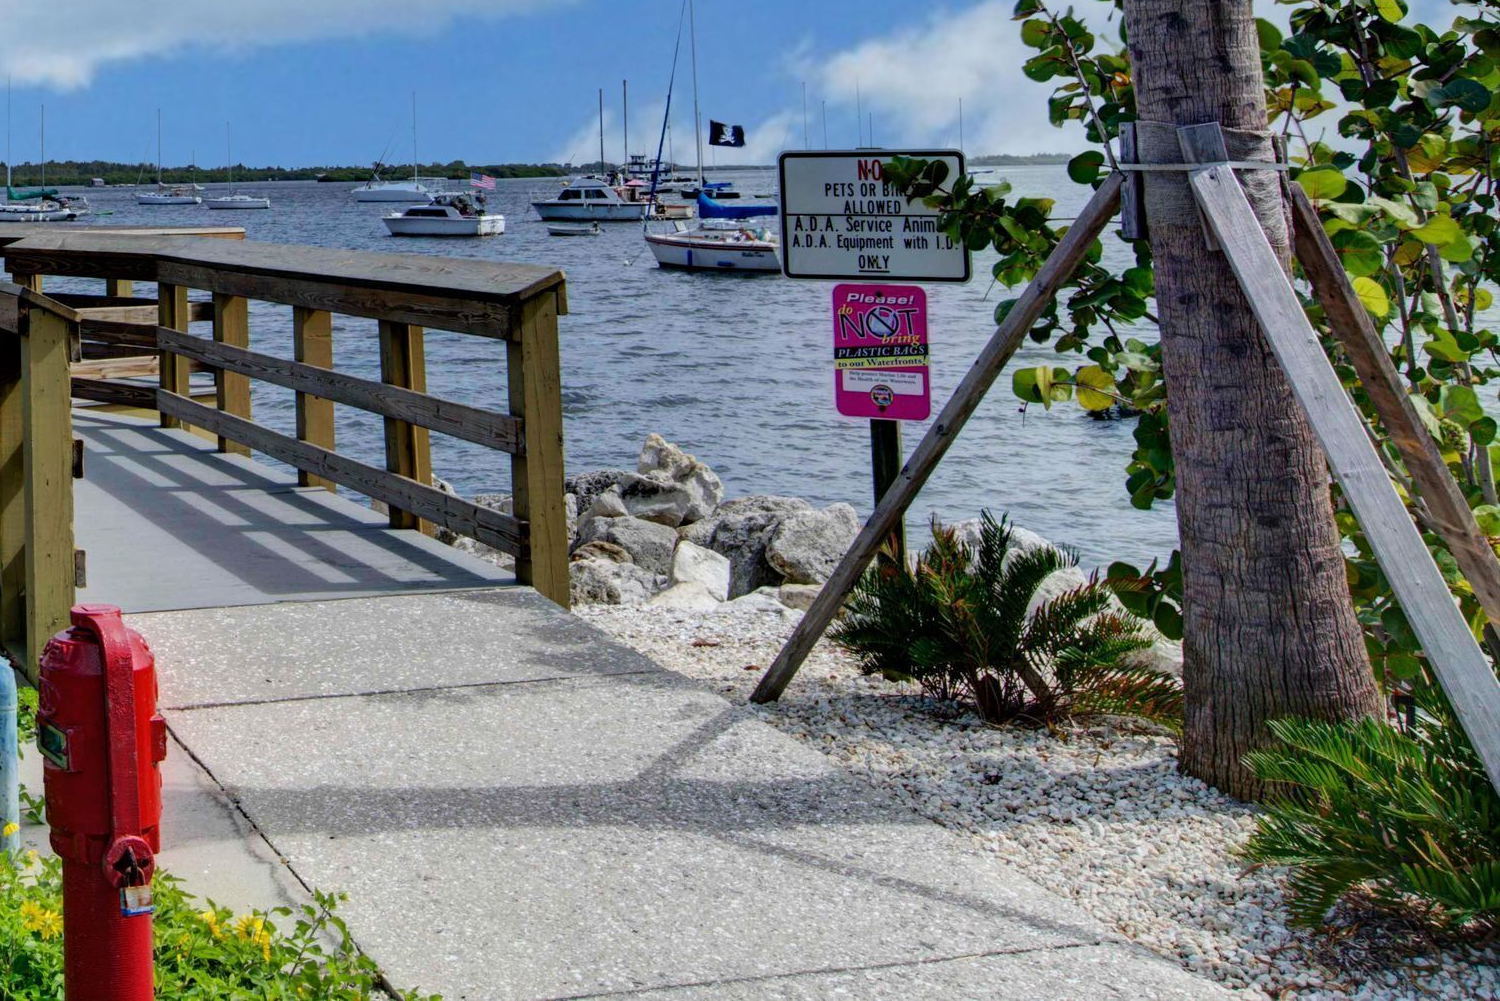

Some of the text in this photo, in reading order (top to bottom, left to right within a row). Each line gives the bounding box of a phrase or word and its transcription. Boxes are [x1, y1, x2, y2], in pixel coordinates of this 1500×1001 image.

[858, 159, 883, 182] NO
[825, 183, 854, 197] PETS
[861, 183, 876, 197] OR
[844, 200, 901, 214] ALLOWED
[795, 217, 839, 232] A.D.A.
[846, 216, 893, 232] Service
[793, 234, 831, 248] A.D.A.
[837, 235, 894, 251] Equipment
[903, 235, 928, 249] with
[858, 255, 890, 269] ONLY
[847, 293, 914, 305] Please!
[838, 304, 853, 315] do
[839, 305, 919, 340] NOT
[882, 333, 920, 347] bring
[838, 345, 925, 358] PLASTIC BAGS
[866, 355, 926, 367] Waterfronts!
